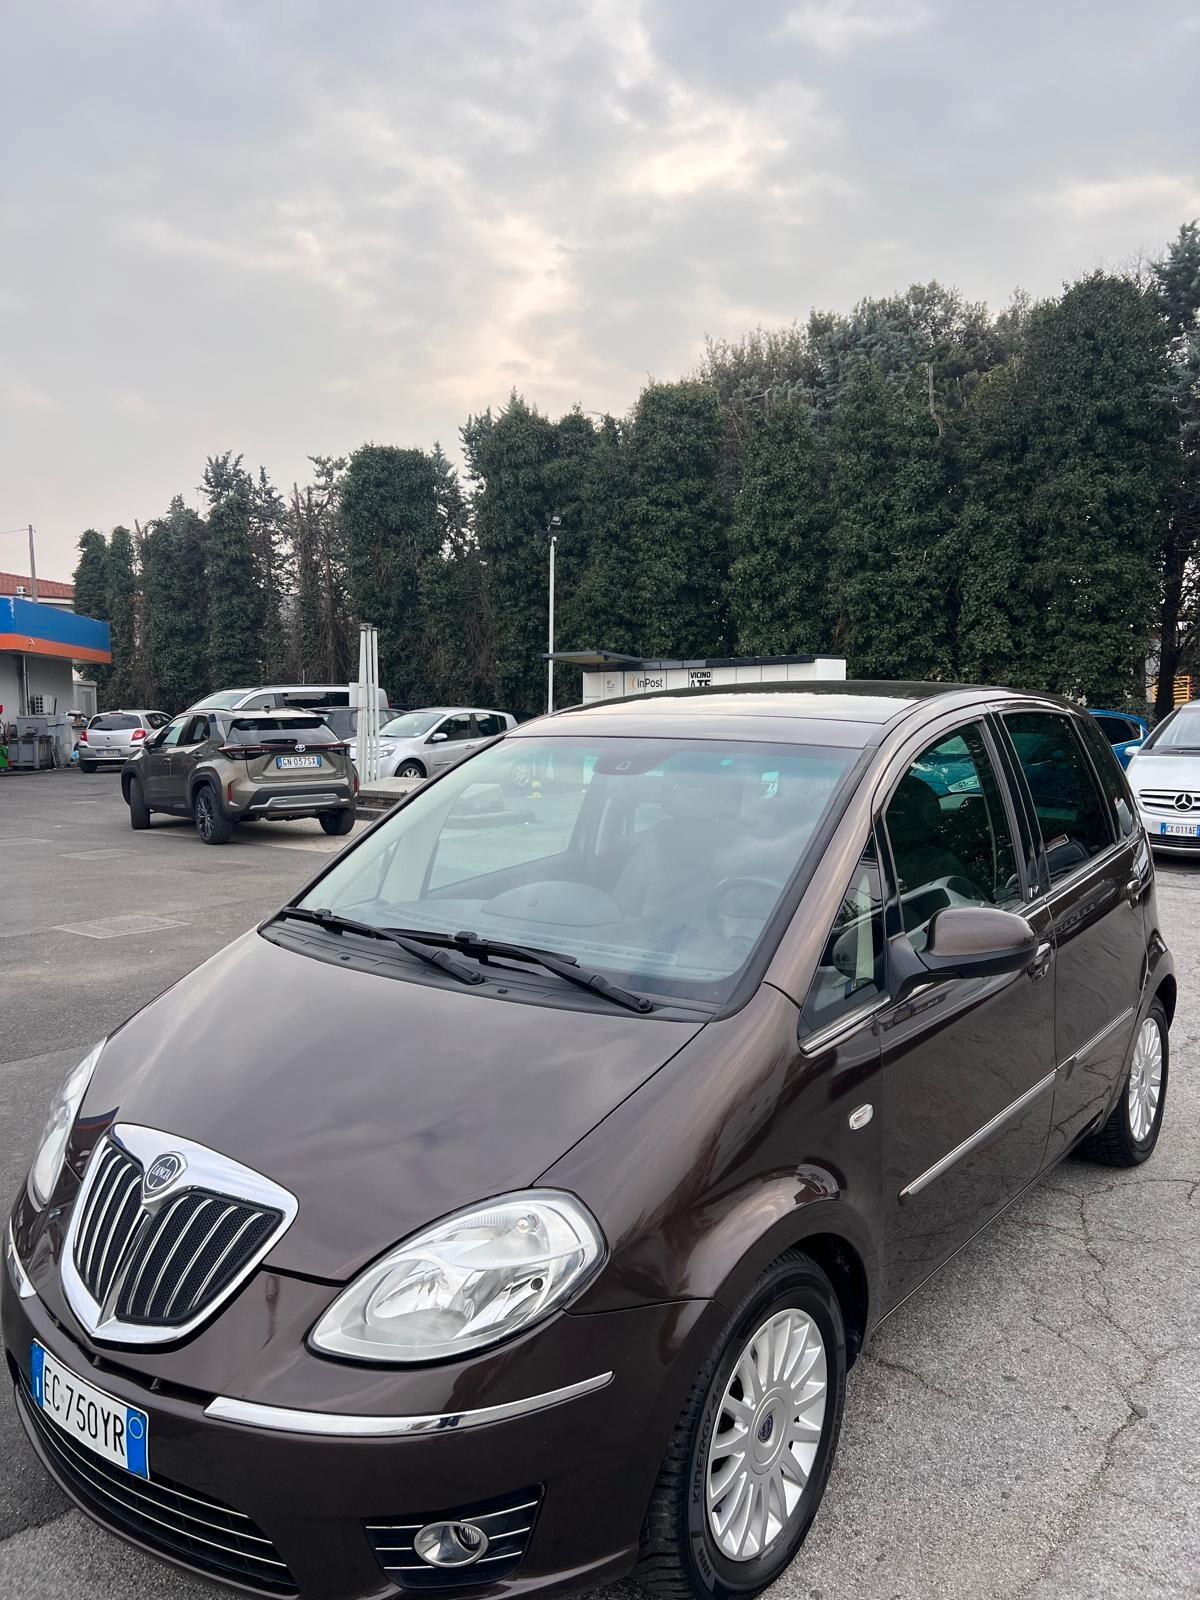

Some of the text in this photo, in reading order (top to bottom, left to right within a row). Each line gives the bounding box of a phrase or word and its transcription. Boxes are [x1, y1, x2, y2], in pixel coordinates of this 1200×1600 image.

[637, 677, 663, 689] InPost
[690, 671, 711, 679] VICINO
[44, 1364, 125, 1457] EC 750YR
[692, 1410, 712, 1504] KINERGY
